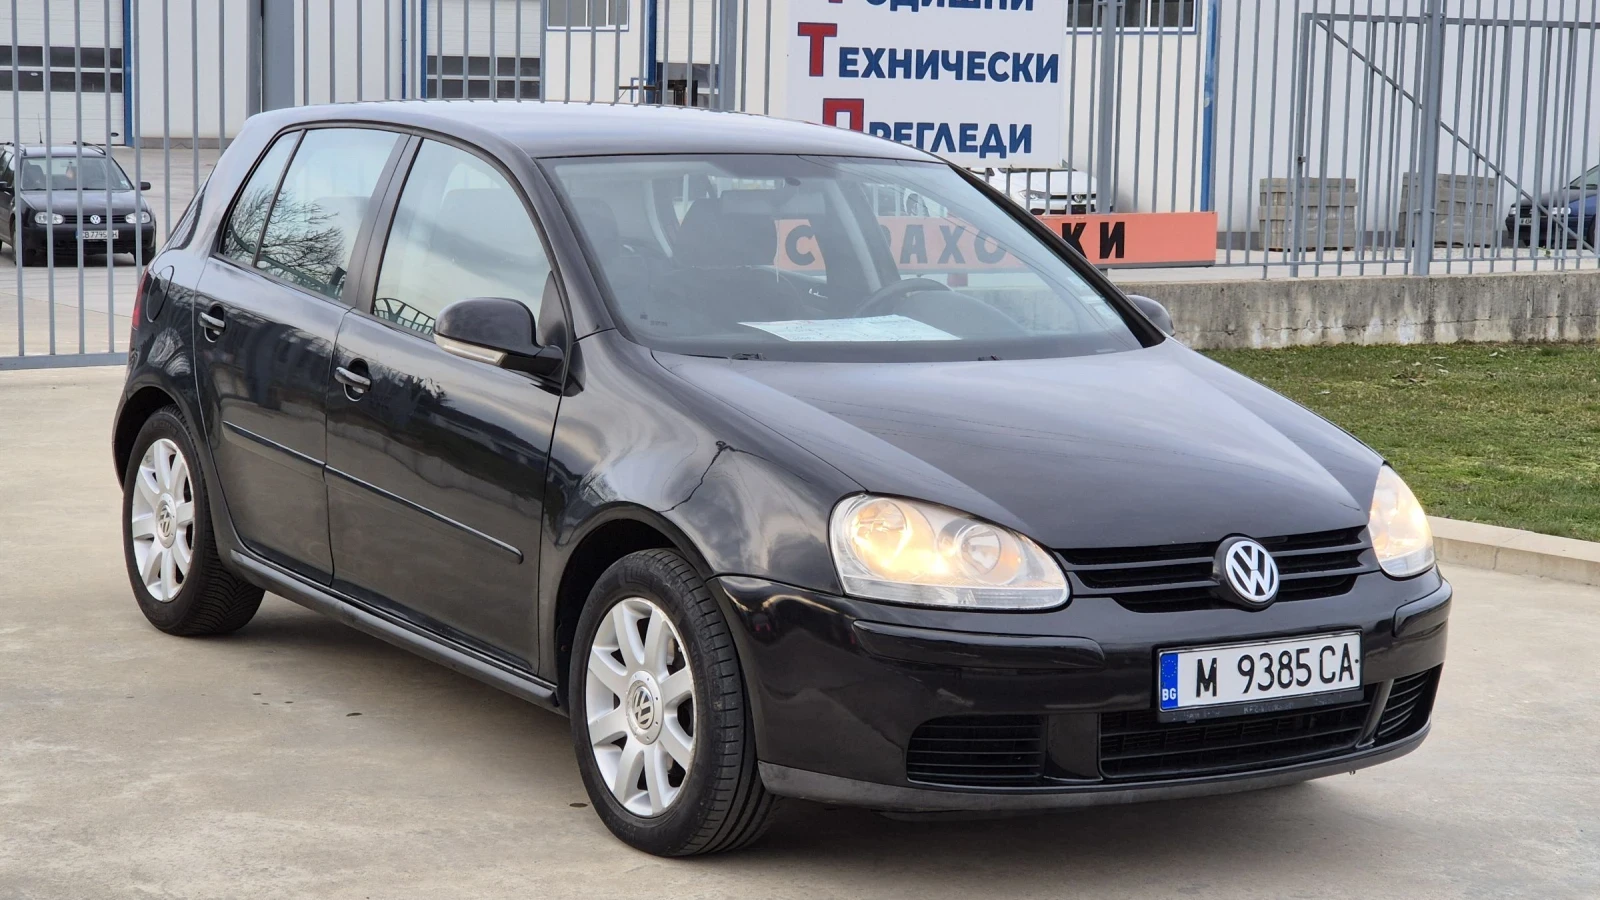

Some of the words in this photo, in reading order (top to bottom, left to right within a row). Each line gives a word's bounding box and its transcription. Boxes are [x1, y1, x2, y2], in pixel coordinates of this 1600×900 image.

[798, 22, 1060, 83] ТЕХНИЧЕСКИ
[1162, 688, 1177, 702] BG
[1195, 657, 1217, 698] M
